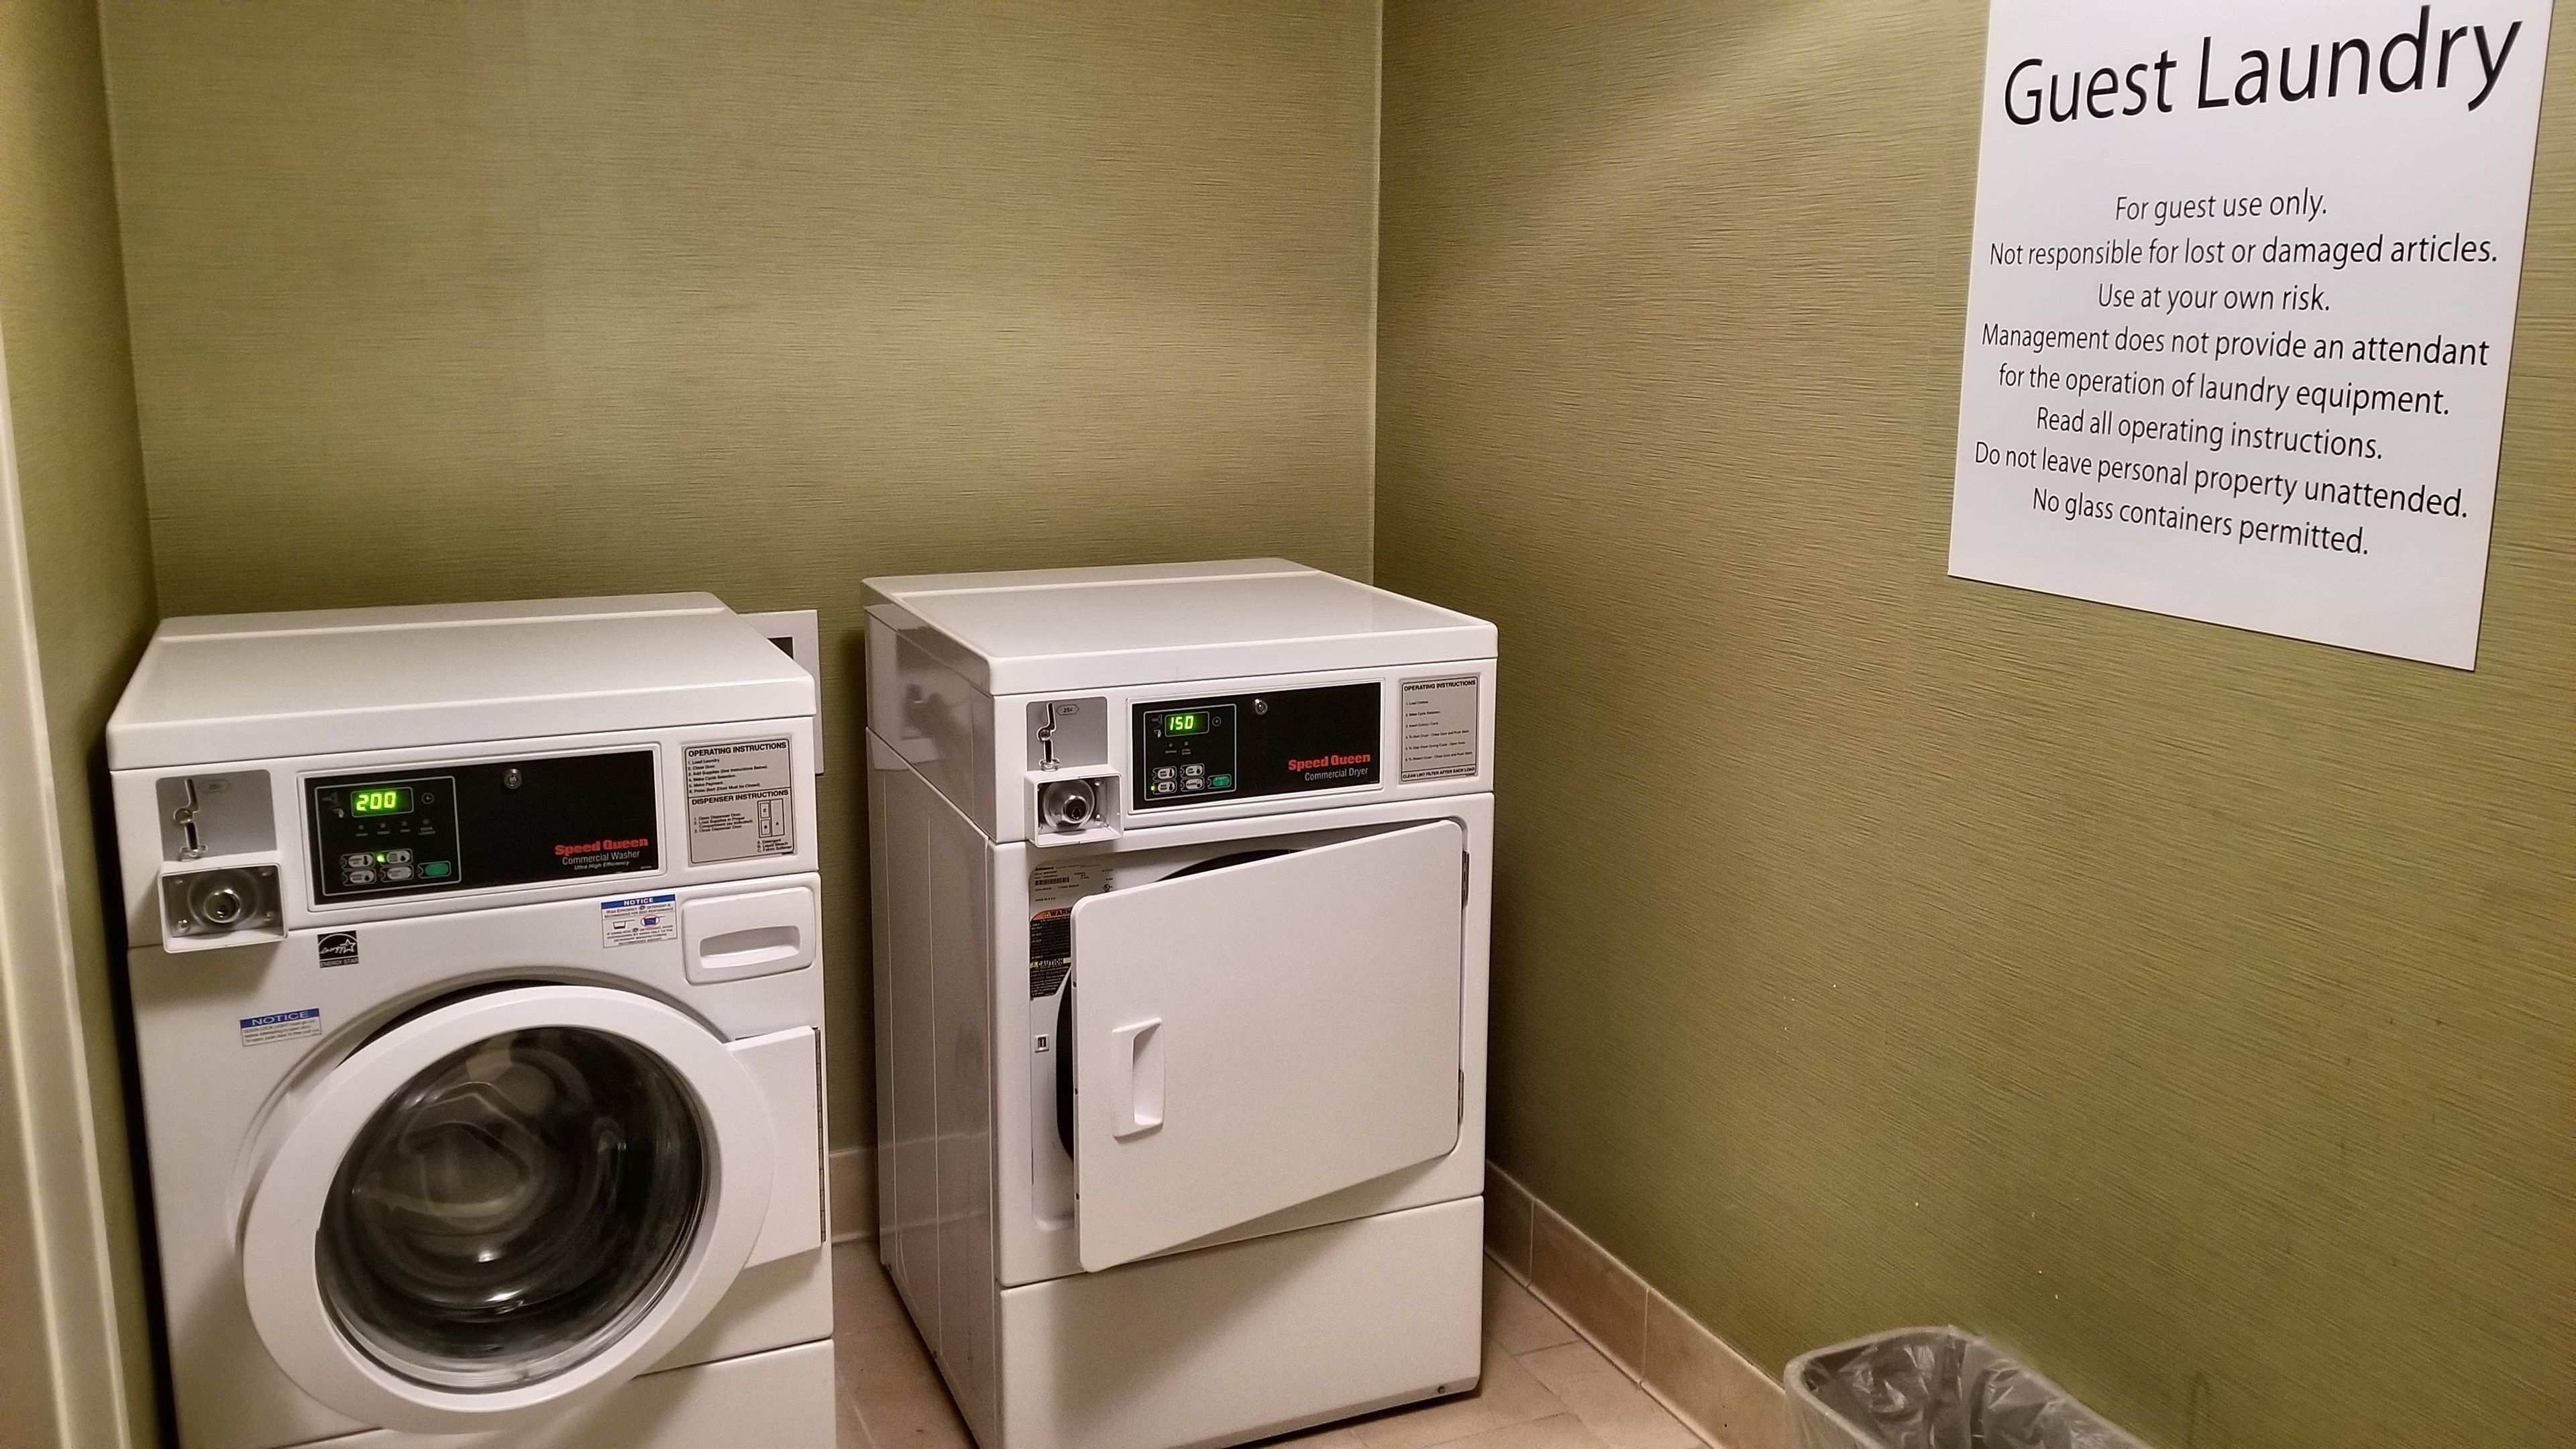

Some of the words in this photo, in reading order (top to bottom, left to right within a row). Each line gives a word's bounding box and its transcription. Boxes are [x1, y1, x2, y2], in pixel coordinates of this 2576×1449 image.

[2004, 50, 2177, 125] Guest
[2198, 5, 2522, 111] Laundry
[2116, 197, 2149, 220] For
[2154, 196, 2216, 226] guest
[2223, 197, 2262, 217] use
[2269, 186, 2326, 222] only.
[1990, 243, 2023, 265] Not
[2029, 238, 2143, 271] responsible
[2149, 237, 2179, 264] for
[2185, 237, 2225, 264] lost
[2232, 244, 2256, 263] or
[2262, 233, 2383, 270] damaged
[2391, 232, 2497, 262] articles.
[2099, 283, 2135, 307] Use
[2141, 286, 2162, 308] at
[2166, 290, 2218, 315] your
[2224, 290, 2273, 310] own
[2282, 283, 2329, 311] risk.
[1982, 323, 2110, 354] Management
[2115, 325, 2165, 352] does
[2171, 332, 2210, 354] not
[2215, 330, 2306, 361] provide
[2314, 339, 2343, 360] an
[2352, 334, 2489, 366] attendant
[1999, 362, 2025, 387] for
[2029, 364, 2060, 389] the
[2065, 370, 2164, 397] operation
[2171, 372, 2196, 398] of
[2200, 372, 2290, 411] laundry
[2296, 382, 2449, 416] equipment.
[2037, 407, 2084, 433] Read
[2090, 410, 2112, 435] all
[2118, 418, 2224, 451] operating
[2231, 421, 2381, 460] instructions.
[1976, 441, 2000, 465] Do
[2006, 449, 2037, 470] not
[2042, 447, 2092, 475] leave
[2098, 460, 2188, 486] personal
[2194, 470, 2298, 505] property
[2304, 477, 2468, 519] unattended.
[2033, 487, 2059, 513] No
[2065, 492, 2114, 521] glass
[2119, 504, 2233, 536] containers
[2239, 519, 2367, 555] permitted.
[1436, 680, 1475, 688] INSTRUCTIONS
[1170, 716, 1193, 731] 150
[688, 747, 731, 757] OPERATING
[733, 742, 786, 753] INSTRUCTIONS
[1288, 757, 1328, 771] Speed
[1331, 754, 1371, 765] Queen
[1305, 769, 1347, 781] Commercial
[1349, 767, 1368, 777] Dryer
[356, 791, 396, 811] 200
[692, 795, 733, 805] DISPENSER
[735, 790, 789, 800] INSTRUCTIONS
[555, 841, 601, 856] Speed
[604, 839, 648, 850] Queen
[562, 854, 609, 865] Commercial
[611, 851, 640, 860] Washer
[343, 957, 359, 965] STAR
[1037, 958, 1063, 967] CAUTION
[252, 1012, 308, 1026] NOTICE
